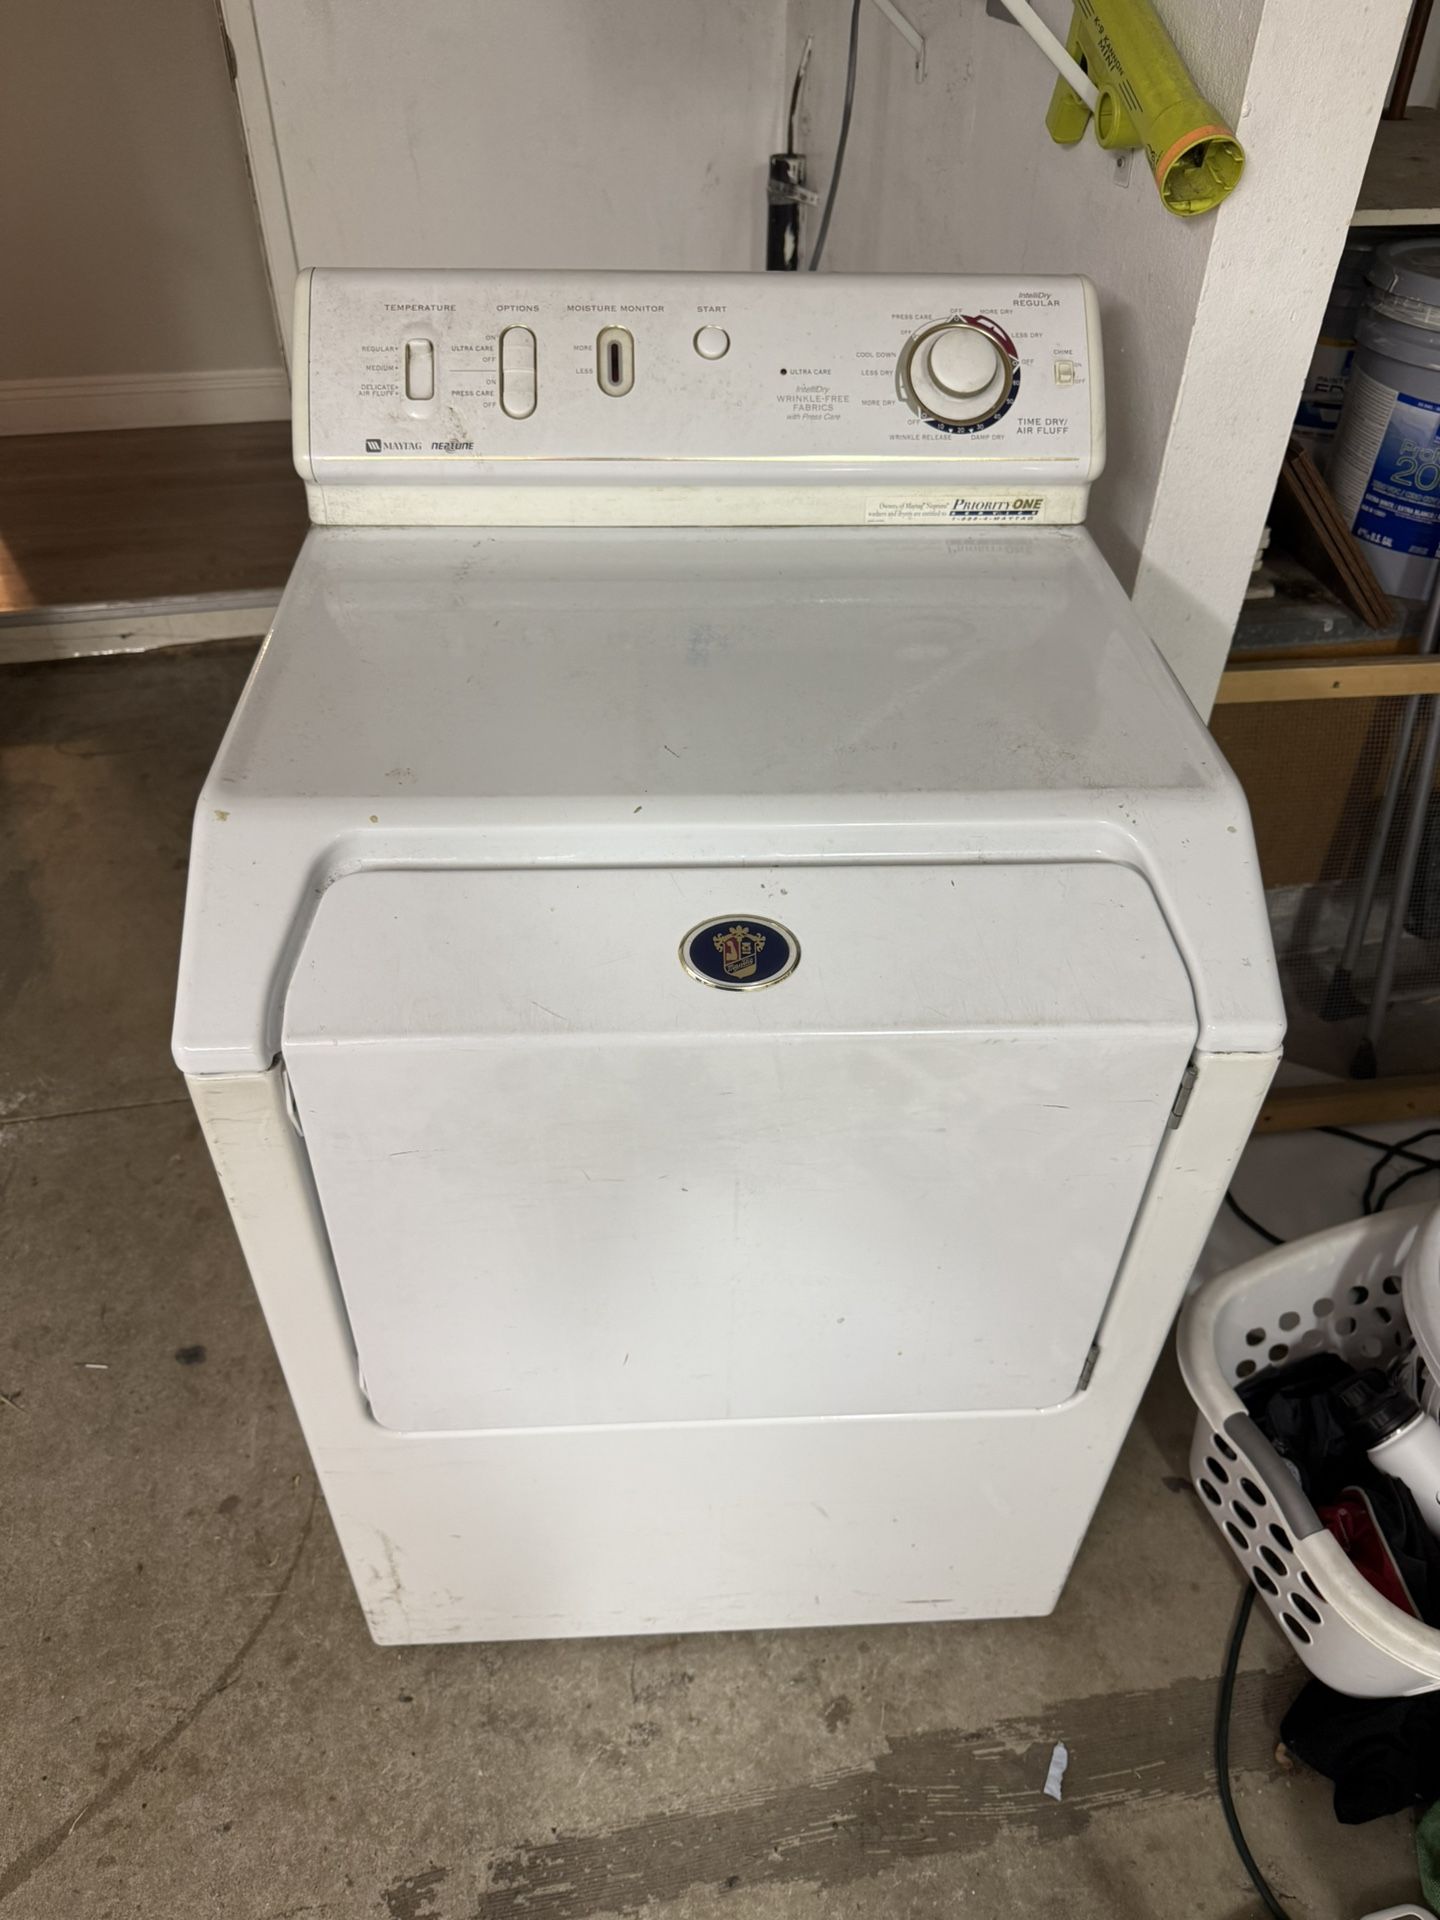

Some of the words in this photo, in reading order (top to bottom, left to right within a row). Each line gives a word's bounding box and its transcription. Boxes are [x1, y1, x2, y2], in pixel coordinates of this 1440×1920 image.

[384, 304, 457, 312] TEMPERATURE
[496, 304, 540, 312] OPTIONS
[567, 305, 617, 313] MOISTURE
[620, 305, 665, 313] MONITOR
[789, 368, 812, 376] ULTRA
[813, 368, 832, 376] CARE
[776, 395, 850, 403] WRINKLE-FREE
[792, 403, 834, 411] FABRICS
[1017, 418, 1041, 426] TIME
[1045, 418, 1069, 426] DRY/
[1016, 427, 1035, 435] AIR
[1037, 427, 1069, 435] FLUFF
[383, 441, 423, 450] MAYTAG
[953, 499, 1010, 510] PRIORITY
[1012, 498, 1044, 510] ONE
